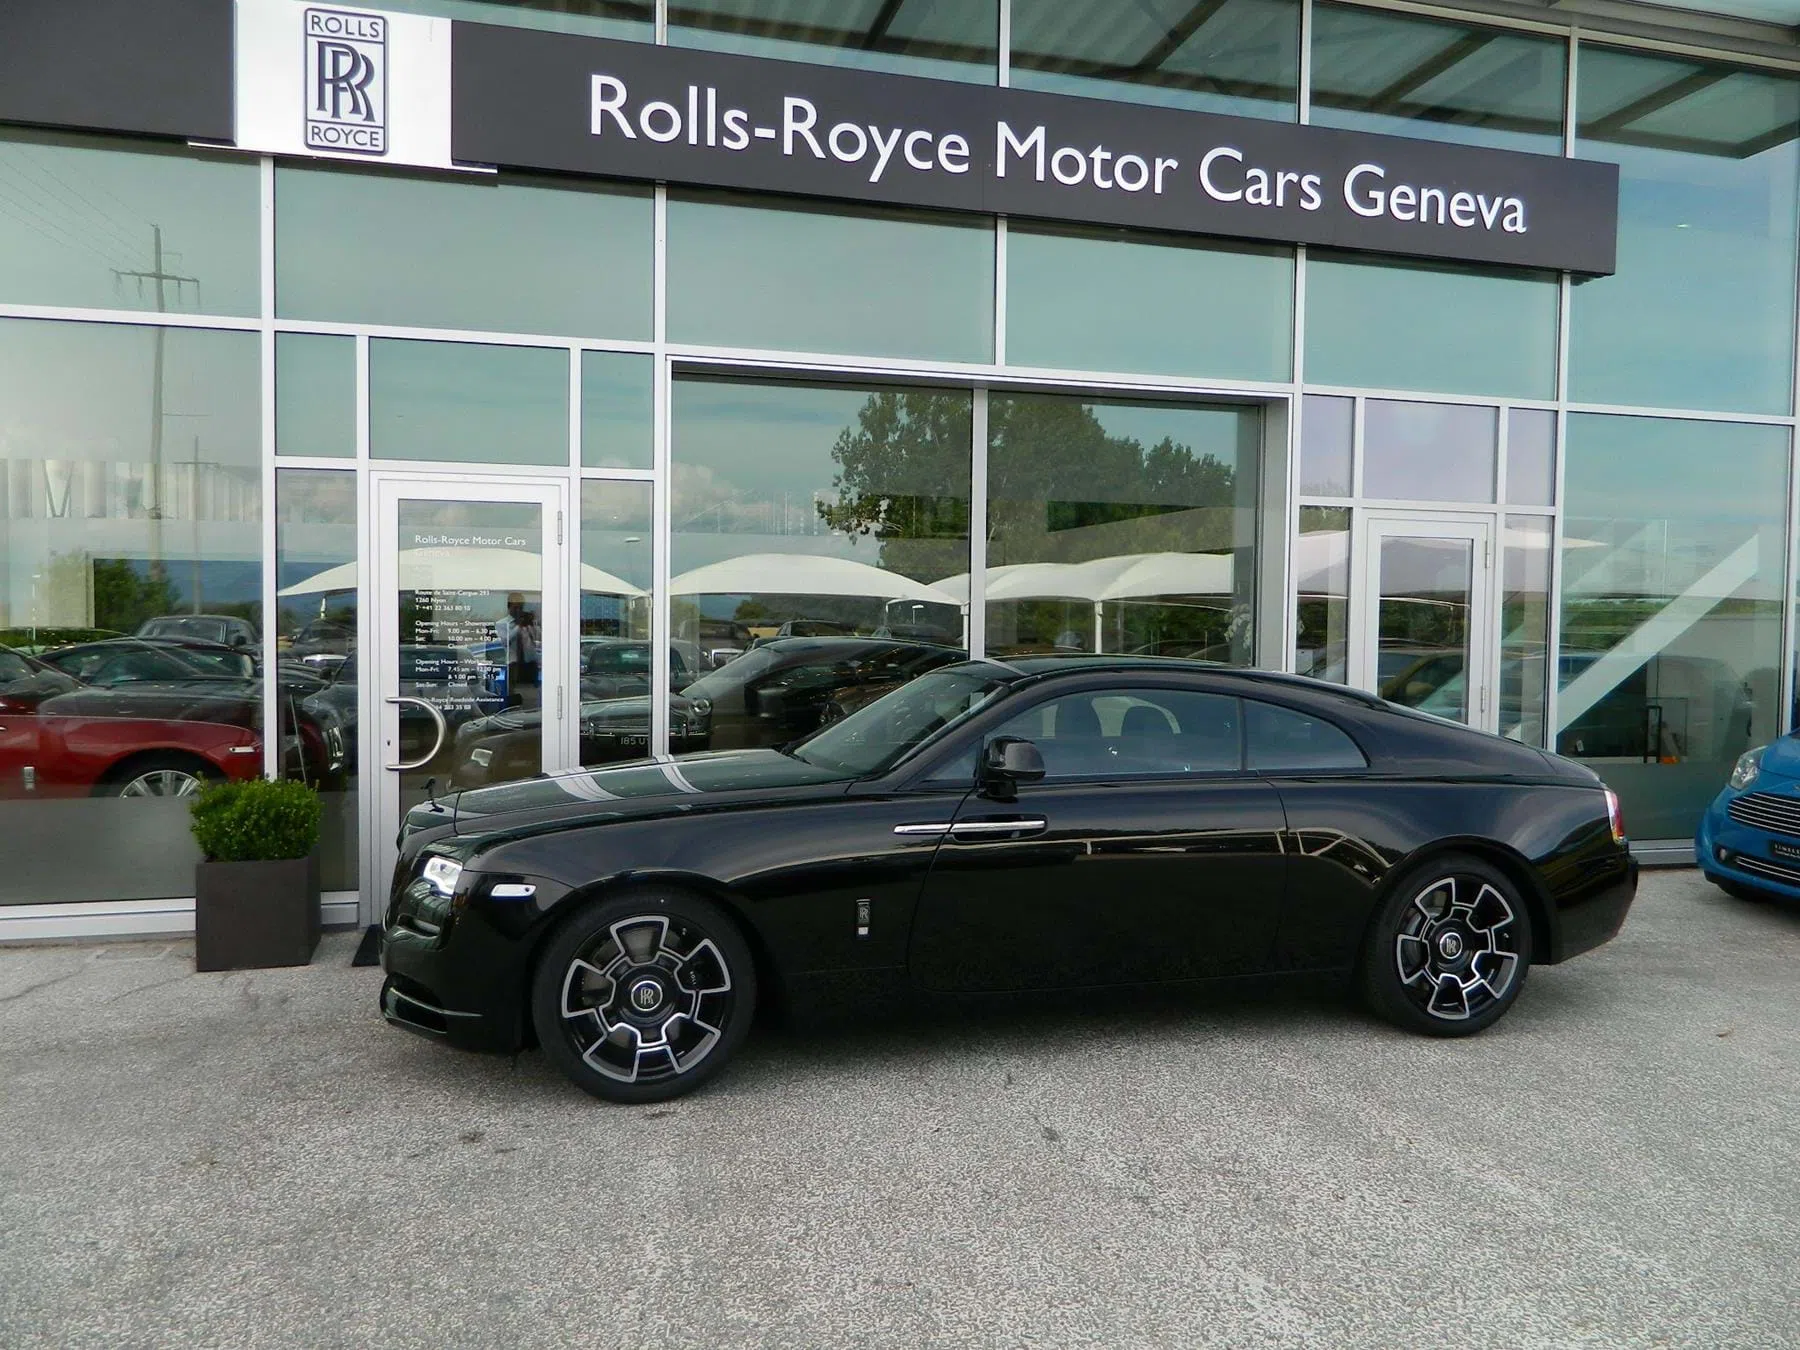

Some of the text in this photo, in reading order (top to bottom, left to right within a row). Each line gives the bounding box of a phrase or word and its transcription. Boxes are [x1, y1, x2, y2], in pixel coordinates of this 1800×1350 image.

[311, 15, 379, 38] ROLLS
[311, 126, 379, 147] ROYCE
[590, 74, 1527, 234] Rolls-Royce Motor Cars Geneva
[415, 534, 526, 546] Rolls-Royce Motor Cars
[620, 736, 636, 745] 185
